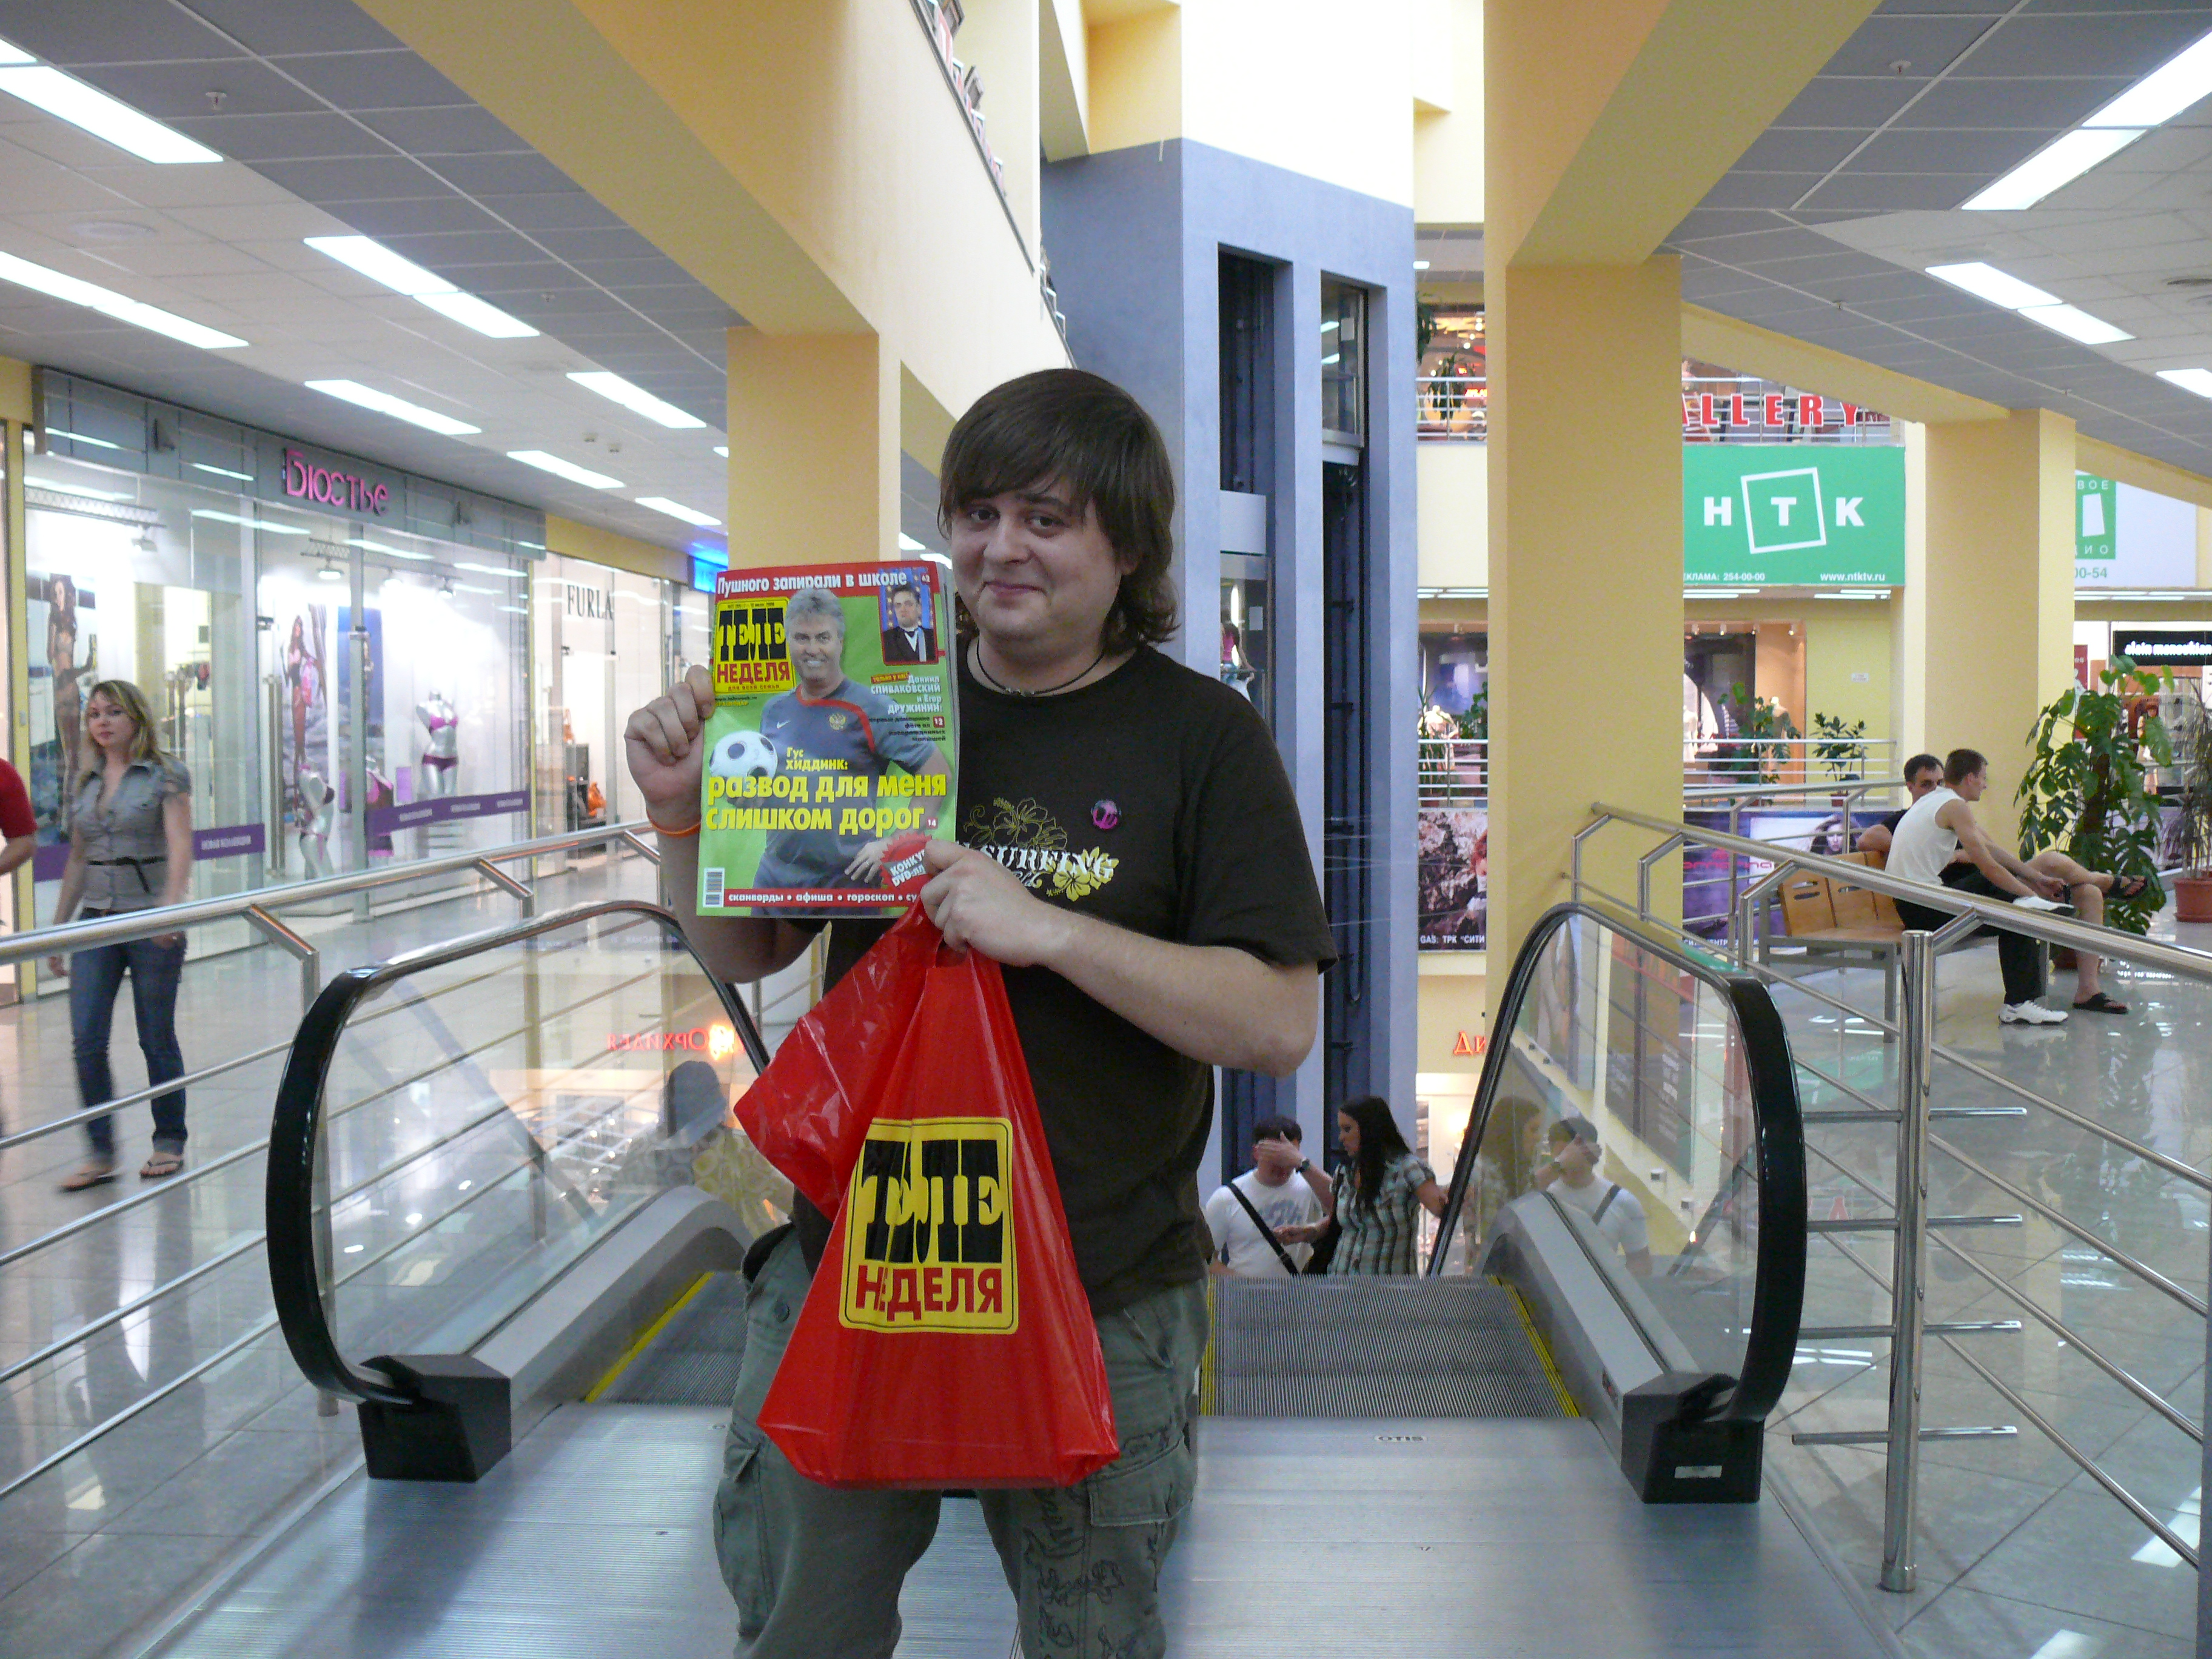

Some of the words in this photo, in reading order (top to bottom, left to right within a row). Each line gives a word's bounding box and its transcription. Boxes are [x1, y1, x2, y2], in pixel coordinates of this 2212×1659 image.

[2077, 480, 2110, 490] ВОЕ
[1723, 572, 1765, 581] 254-00-00
[1820, 572, 1886, 581] www.ntktv.ru
[717, 577, 769, 597] Пушного
[774, 574, 842, 591] запирали
[846, 574, 854, 587] в
[859, 572, 907, 587] школе
[566, 583, 614, 621] FURLA
[719, 608, 786, 662] ТЕЛЕ
[717, 662, 790, 685] НЕДЕЛЯ
[908, 674, 940, 685] Даниил
[871, 683, 940, 694] СПИВАКОВСКИЙ
[923, 694, 942, 704] Егор
[786, 747, 804, 758] Гус
[708, 776, 809, 805] развод
[815, 775, 868, 803] для
[877, 773, 947, 797] меня
[706, 808, 833, 831] слишком
[839, 806, 925, 837] дорог
[927, 819, 937, 828] 14
[729, 893, 784, 903] сканворды
[796, 892, 833, 903] афиша
[847, 893, 895, 903] гороскоп
[1442, 934, 1457, 944] ТРК
[856, 1265, 1002, 1322] НДЕЛЯ
